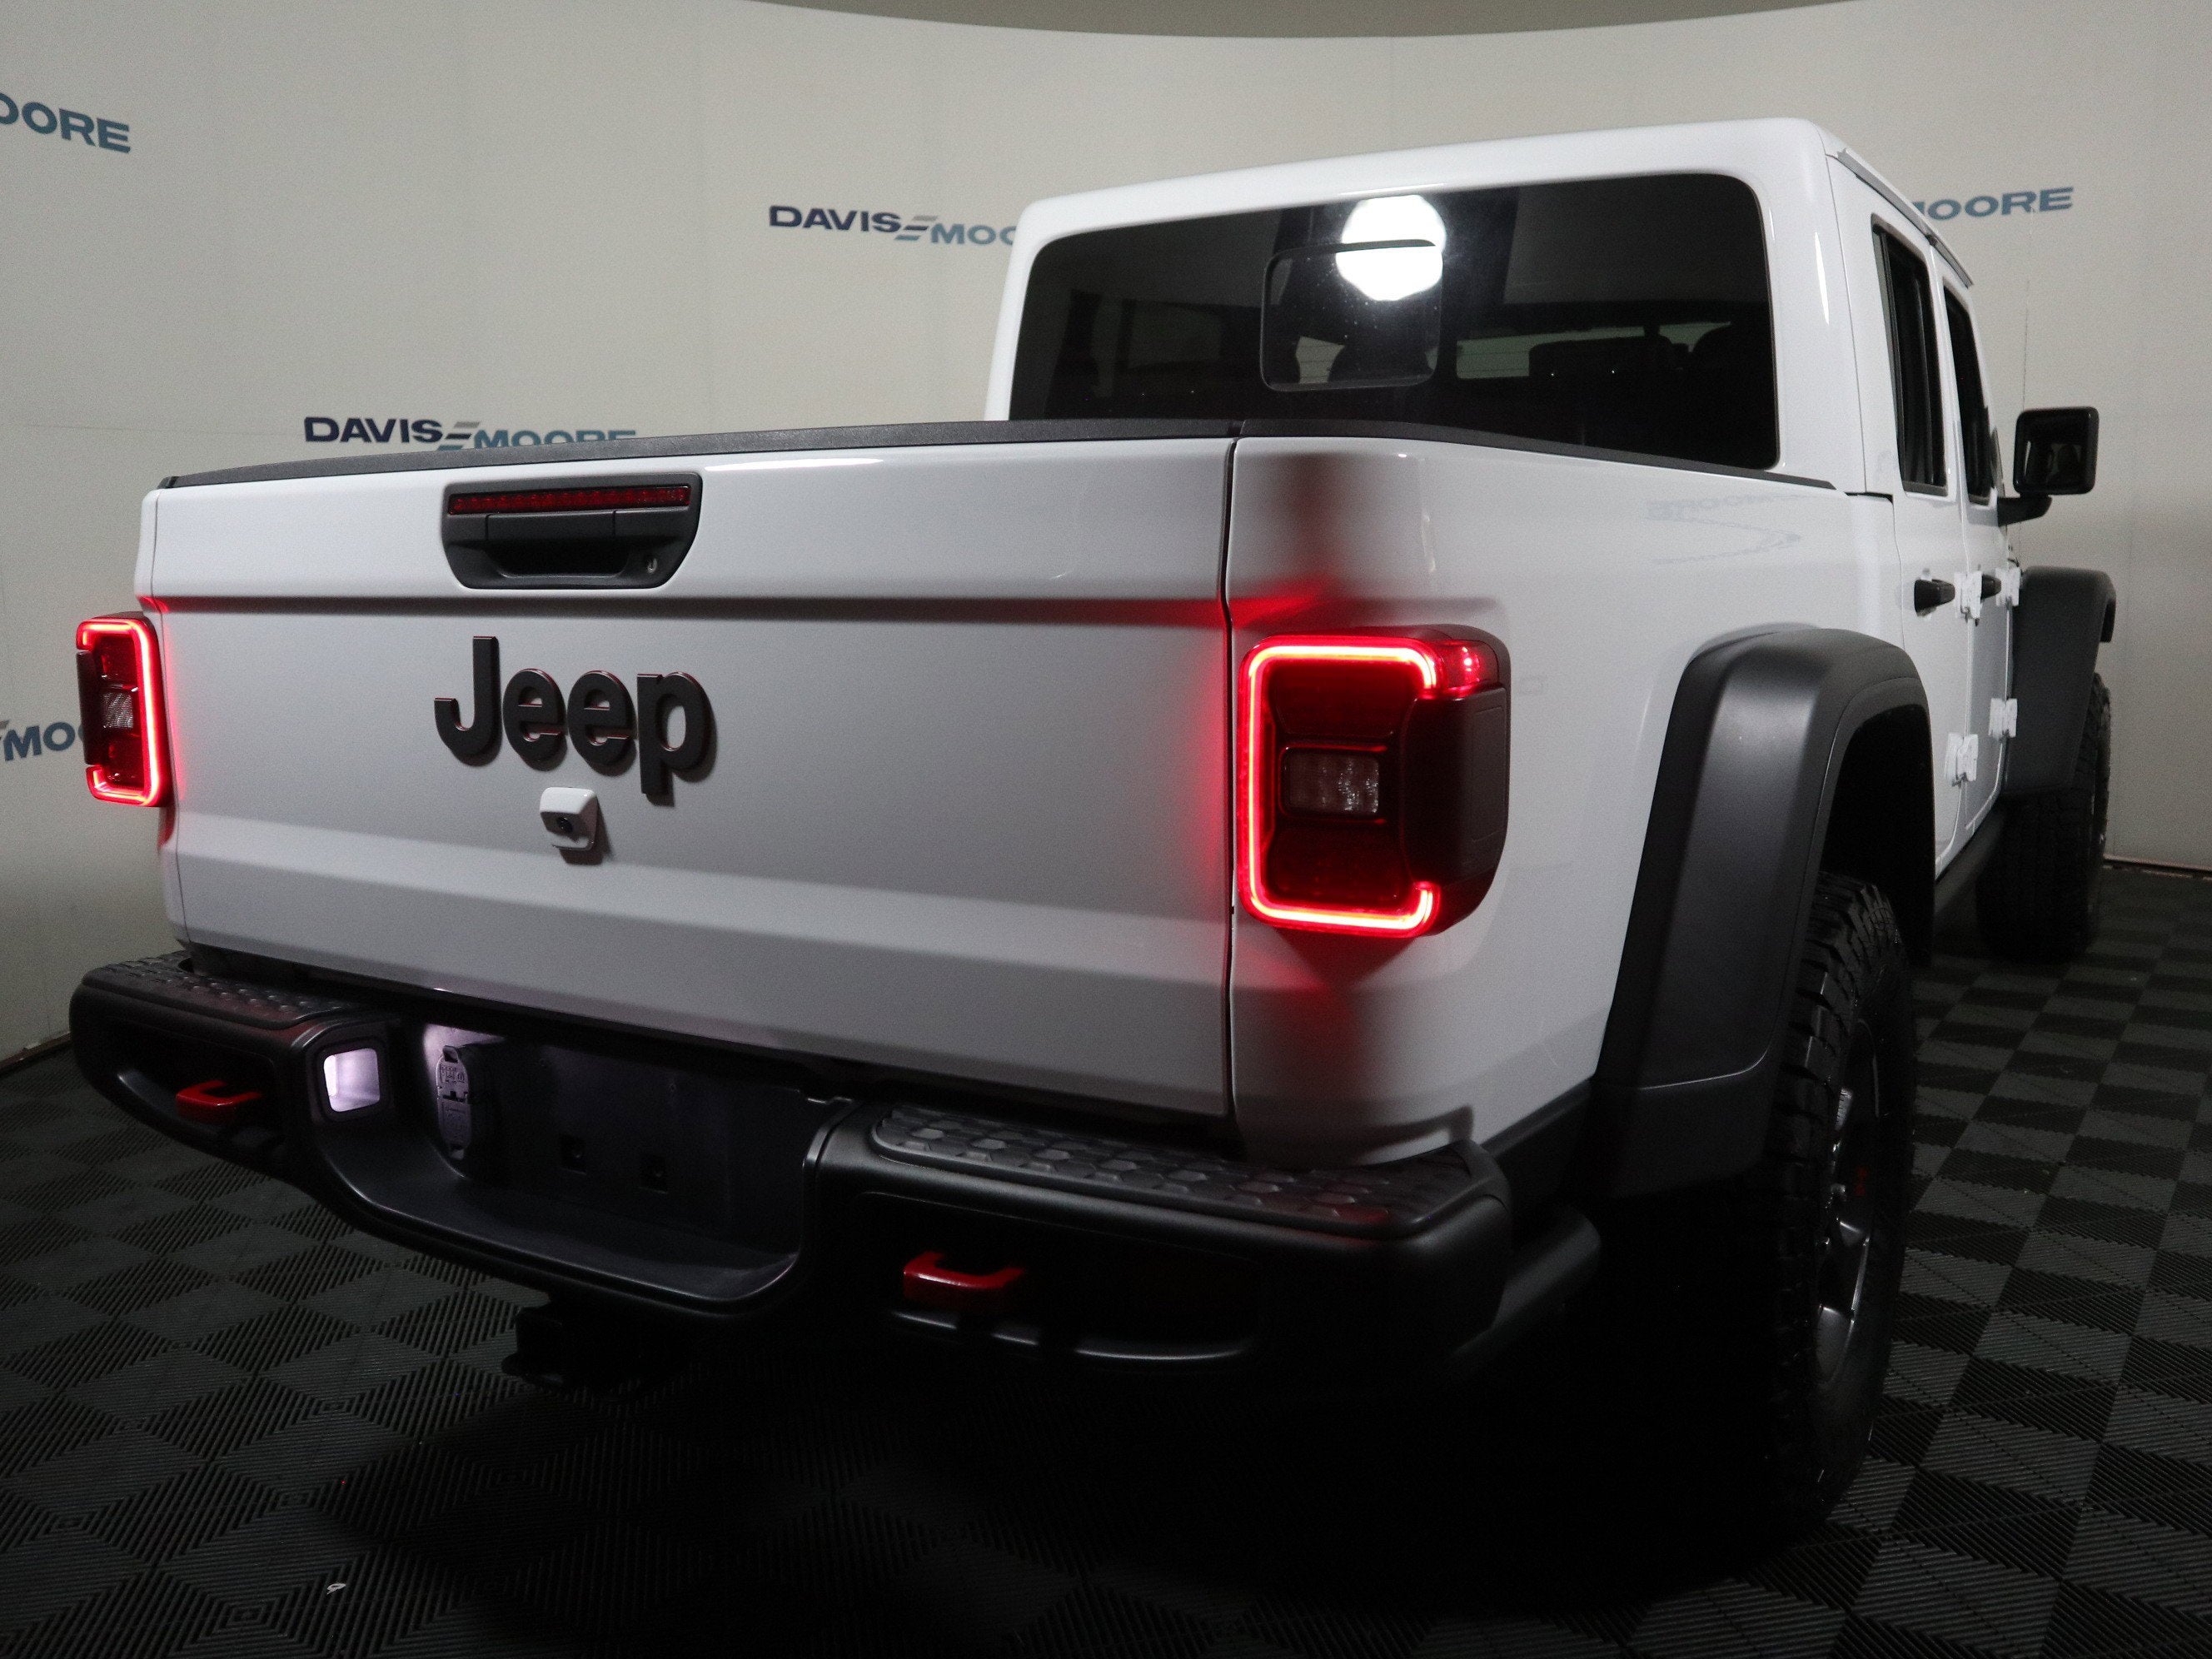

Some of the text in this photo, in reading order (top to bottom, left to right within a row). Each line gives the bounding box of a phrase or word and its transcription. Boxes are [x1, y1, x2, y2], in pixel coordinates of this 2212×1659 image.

[769, 205, 901, 233] DAVIS
[1912, 186, 2074, 221] OORE
[304, 416, 442, 444] DAVIS
[434, 635, 710, 797] Jeep
[3, 721, 82, 761] MO
